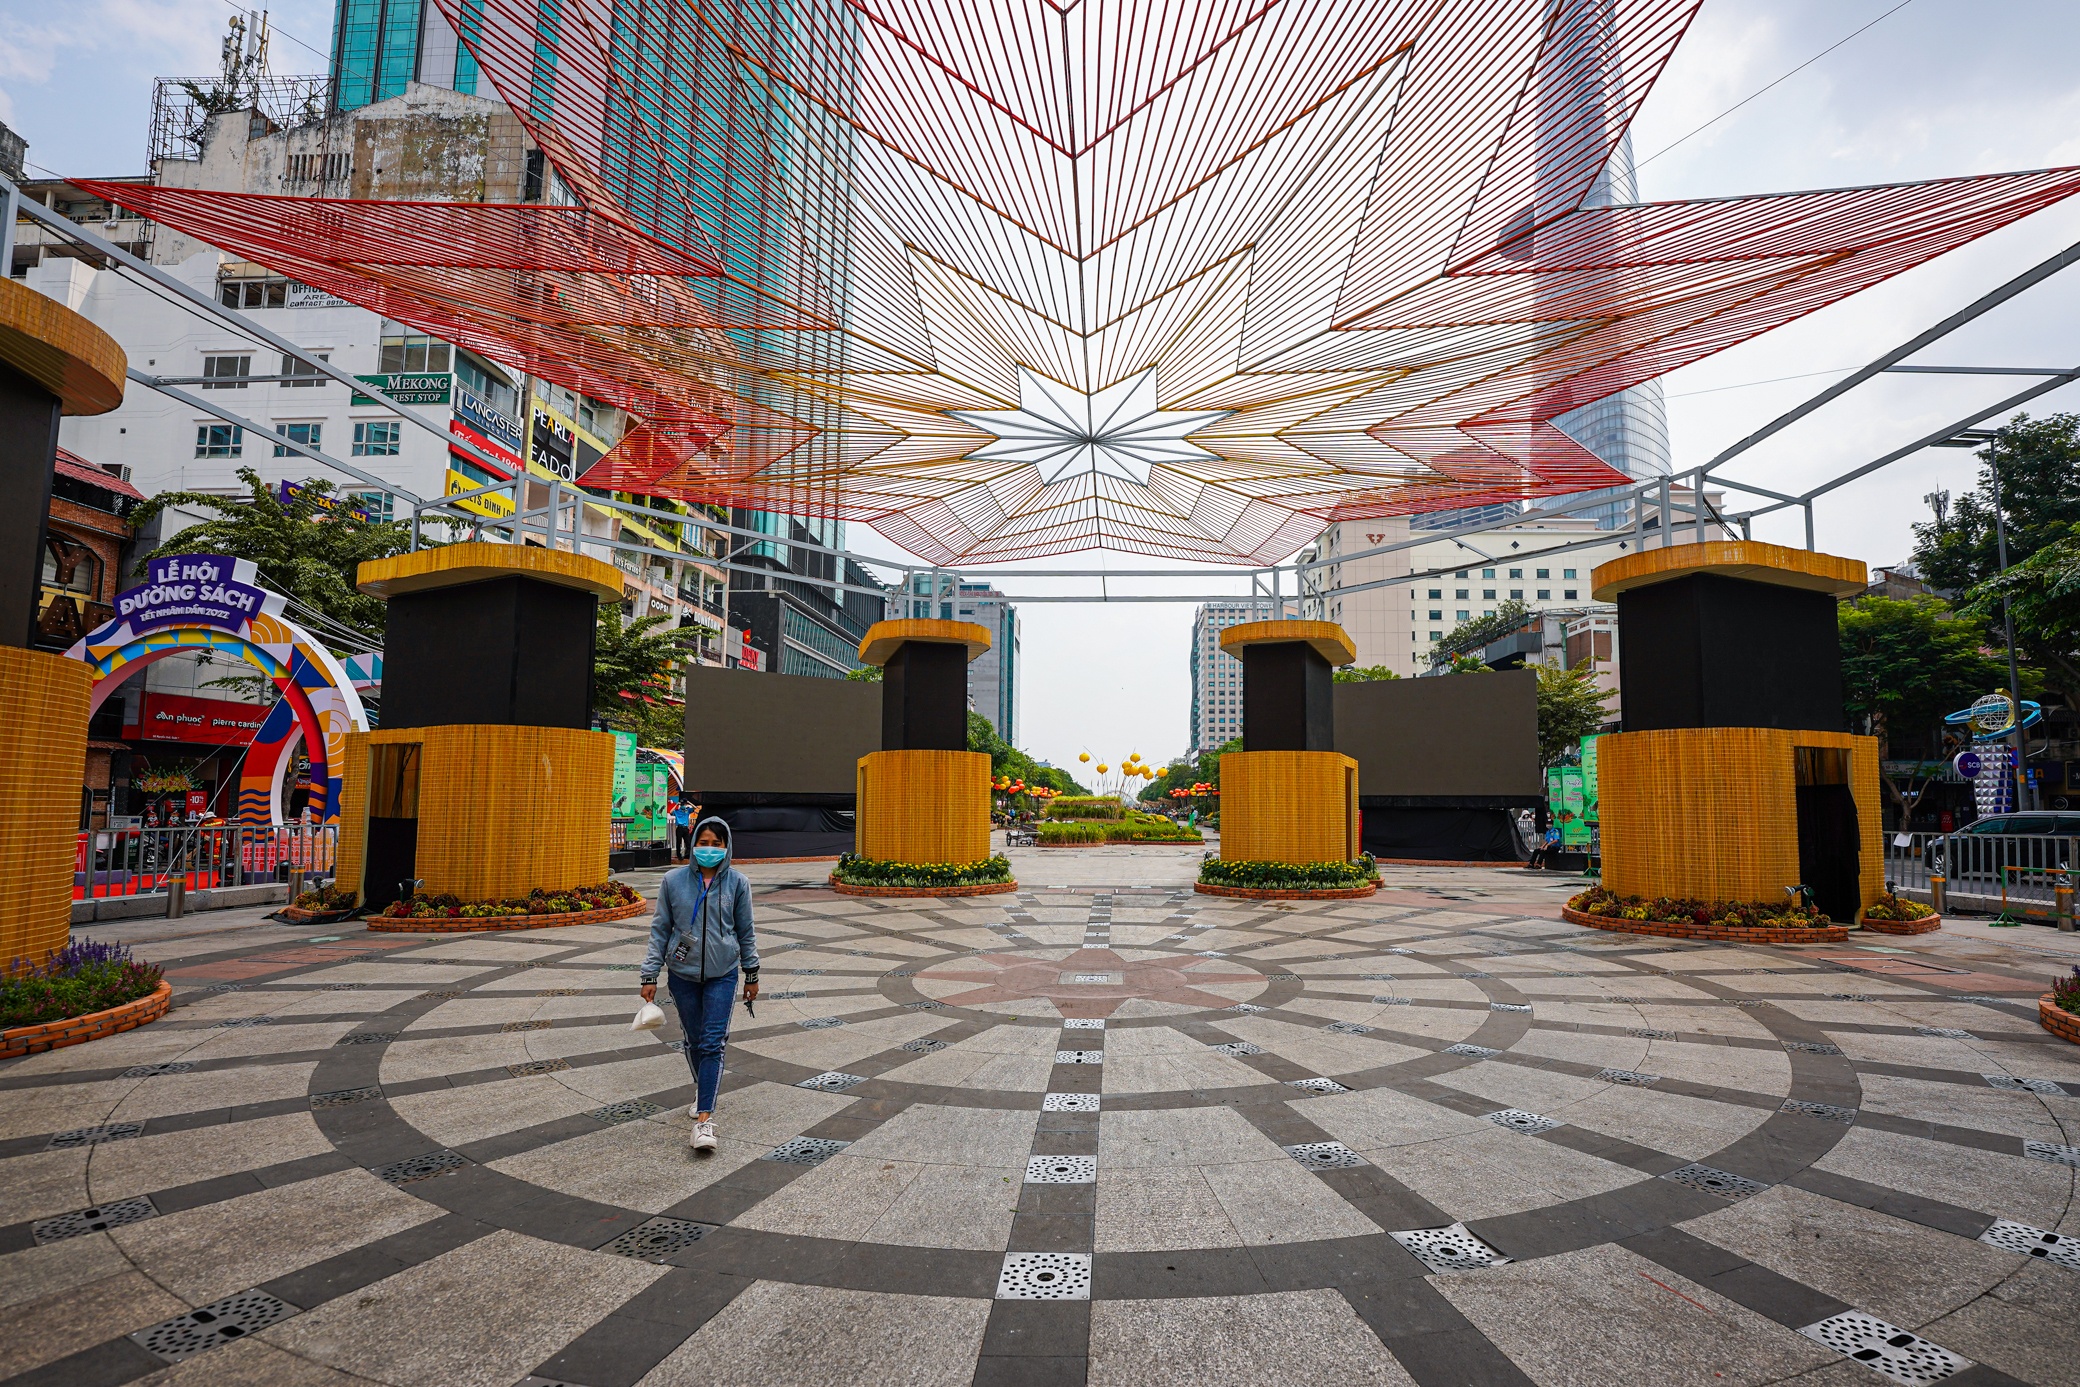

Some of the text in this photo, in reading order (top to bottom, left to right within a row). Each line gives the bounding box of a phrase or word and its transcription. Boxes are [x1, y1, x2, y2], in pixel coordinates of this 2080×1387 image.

[292, 284, 321, 294] OFFIC
[386, 375, 448, 390] MEKONG
[392, 393, 441, 402] REST STOP
[464, 394, 523, 440] LANCASTER
[475, 415, 511, 441] LINCOLN
[530, 444, 572, 482] FADO
[484, 498, 502, 515] ĐÌNH
[157, 559, 220, 584] LỄ HỘI
[120, 583, 256, 616] ĐƯỜNG SÁCH
[651, 599, 669, 612] OOPS!
[140, 609, 157, 622] TẾT
[206, 607, 229, 620] 2022
[212, 718, 262, 729] pierre cardin
